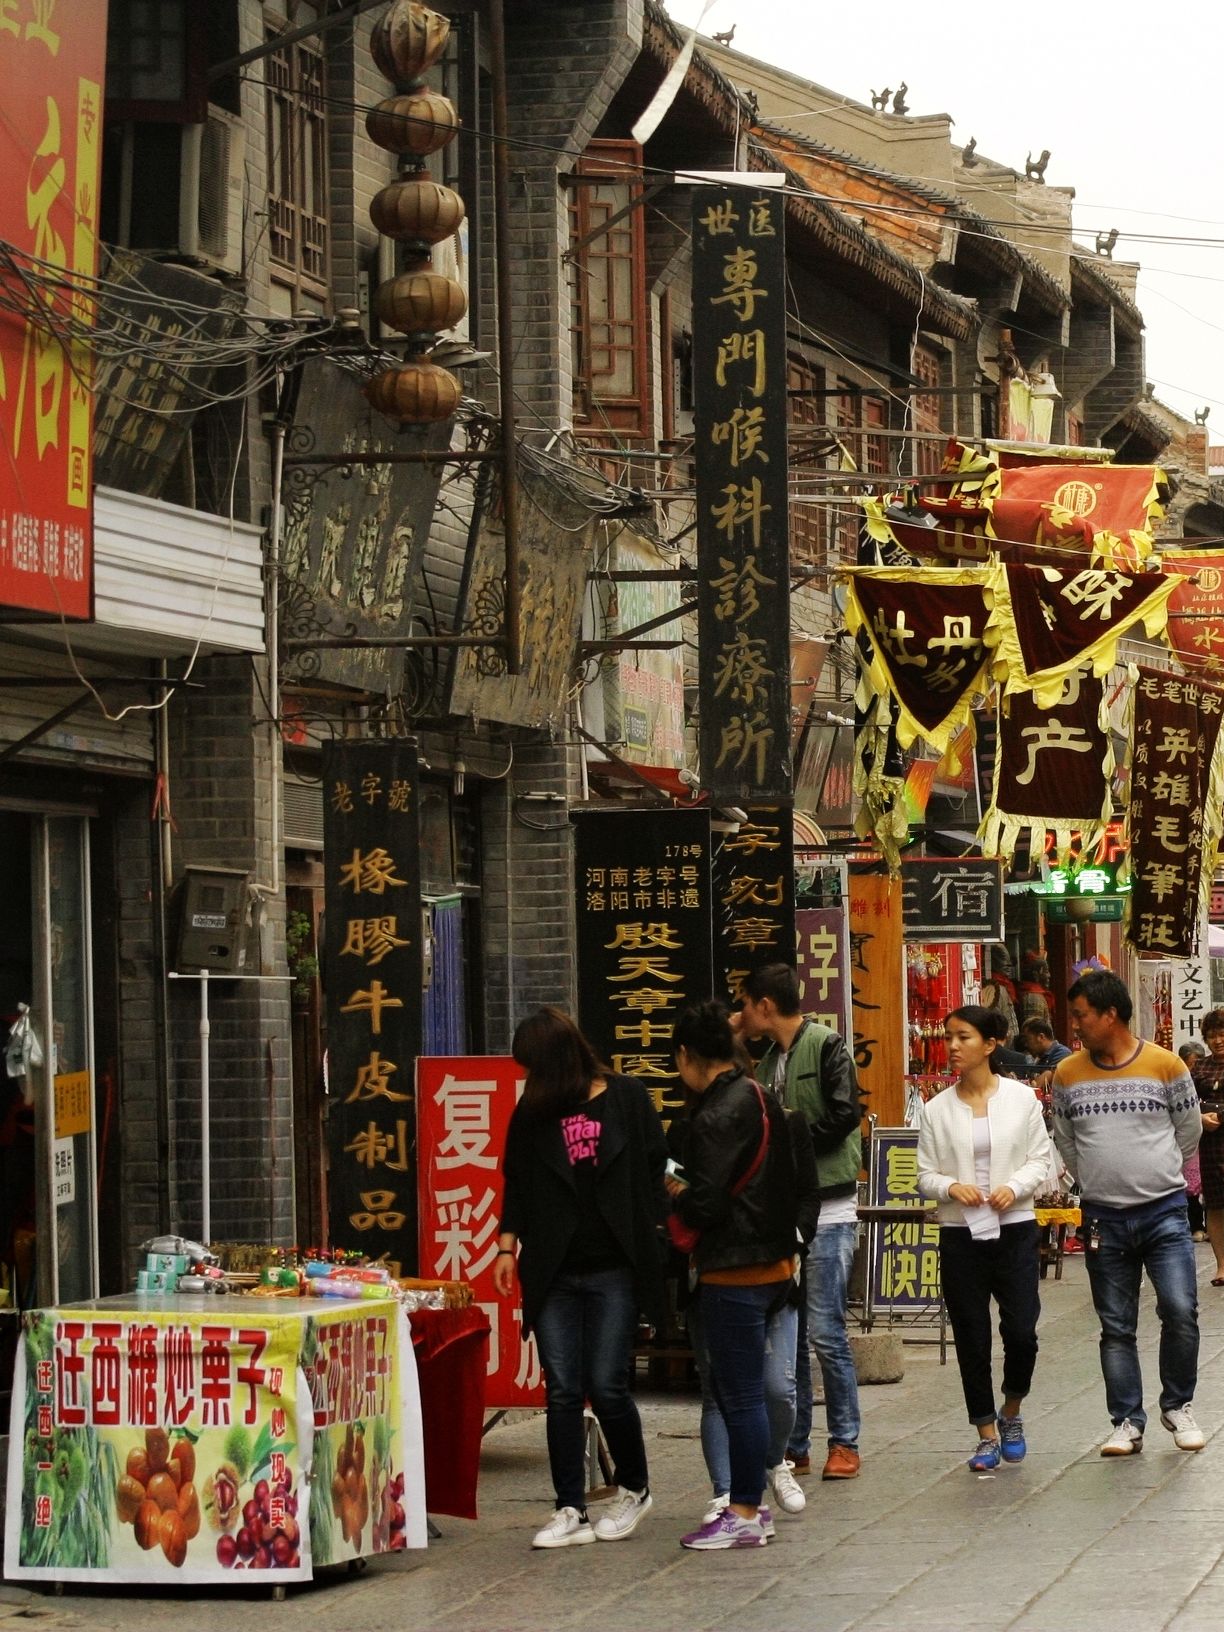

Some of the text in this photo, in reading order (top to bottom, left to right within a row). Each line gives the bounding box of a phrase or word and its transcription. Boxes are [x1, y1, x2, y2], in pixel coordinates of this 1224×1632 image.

[709, 246, 777, 786] 專門喉科診療所
[1138, 676, 1223, 716] 毛笔世家
[331, 774, 411, 813] 老字號
[585, 866, 700, 889] 河南老字号
[664, 845, 702, 858] 178号
[585, 888, 700, 911] 洛阳市非遗
[338, 847, 413, 1231] 橡膠牛皮制品
[56, 1321, 267, 1426] 迁西糖炒栗子
[36, 1360, 54, 1528] 迁西一绝
[269, 1365, 286, 1530] 现炒现卖
